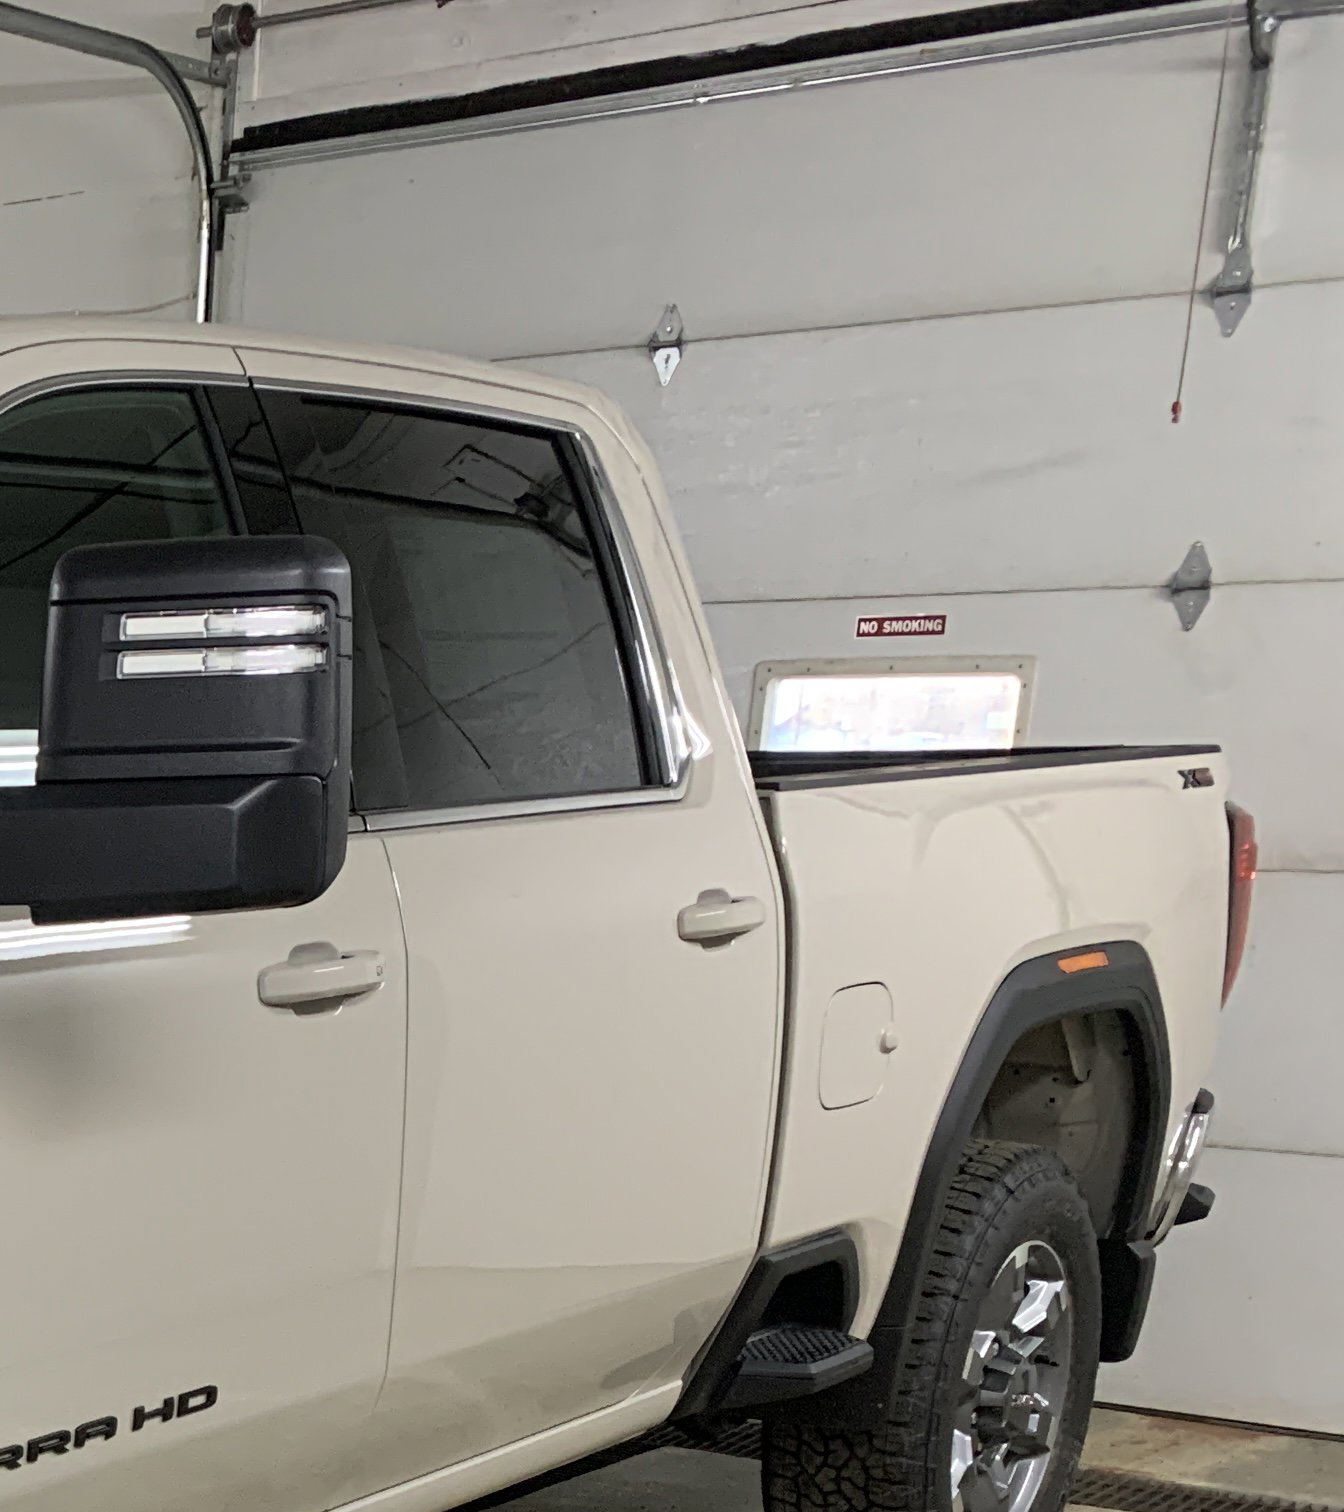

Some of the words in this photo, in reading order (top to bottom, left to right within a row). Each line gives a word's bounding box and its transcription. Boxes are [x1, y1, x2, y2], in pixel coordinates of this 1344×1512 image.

[859, 620, 878, 634] NO
[882, 619, 943, 633] SMOKING
[131, 1384, 219, 1432] HD
